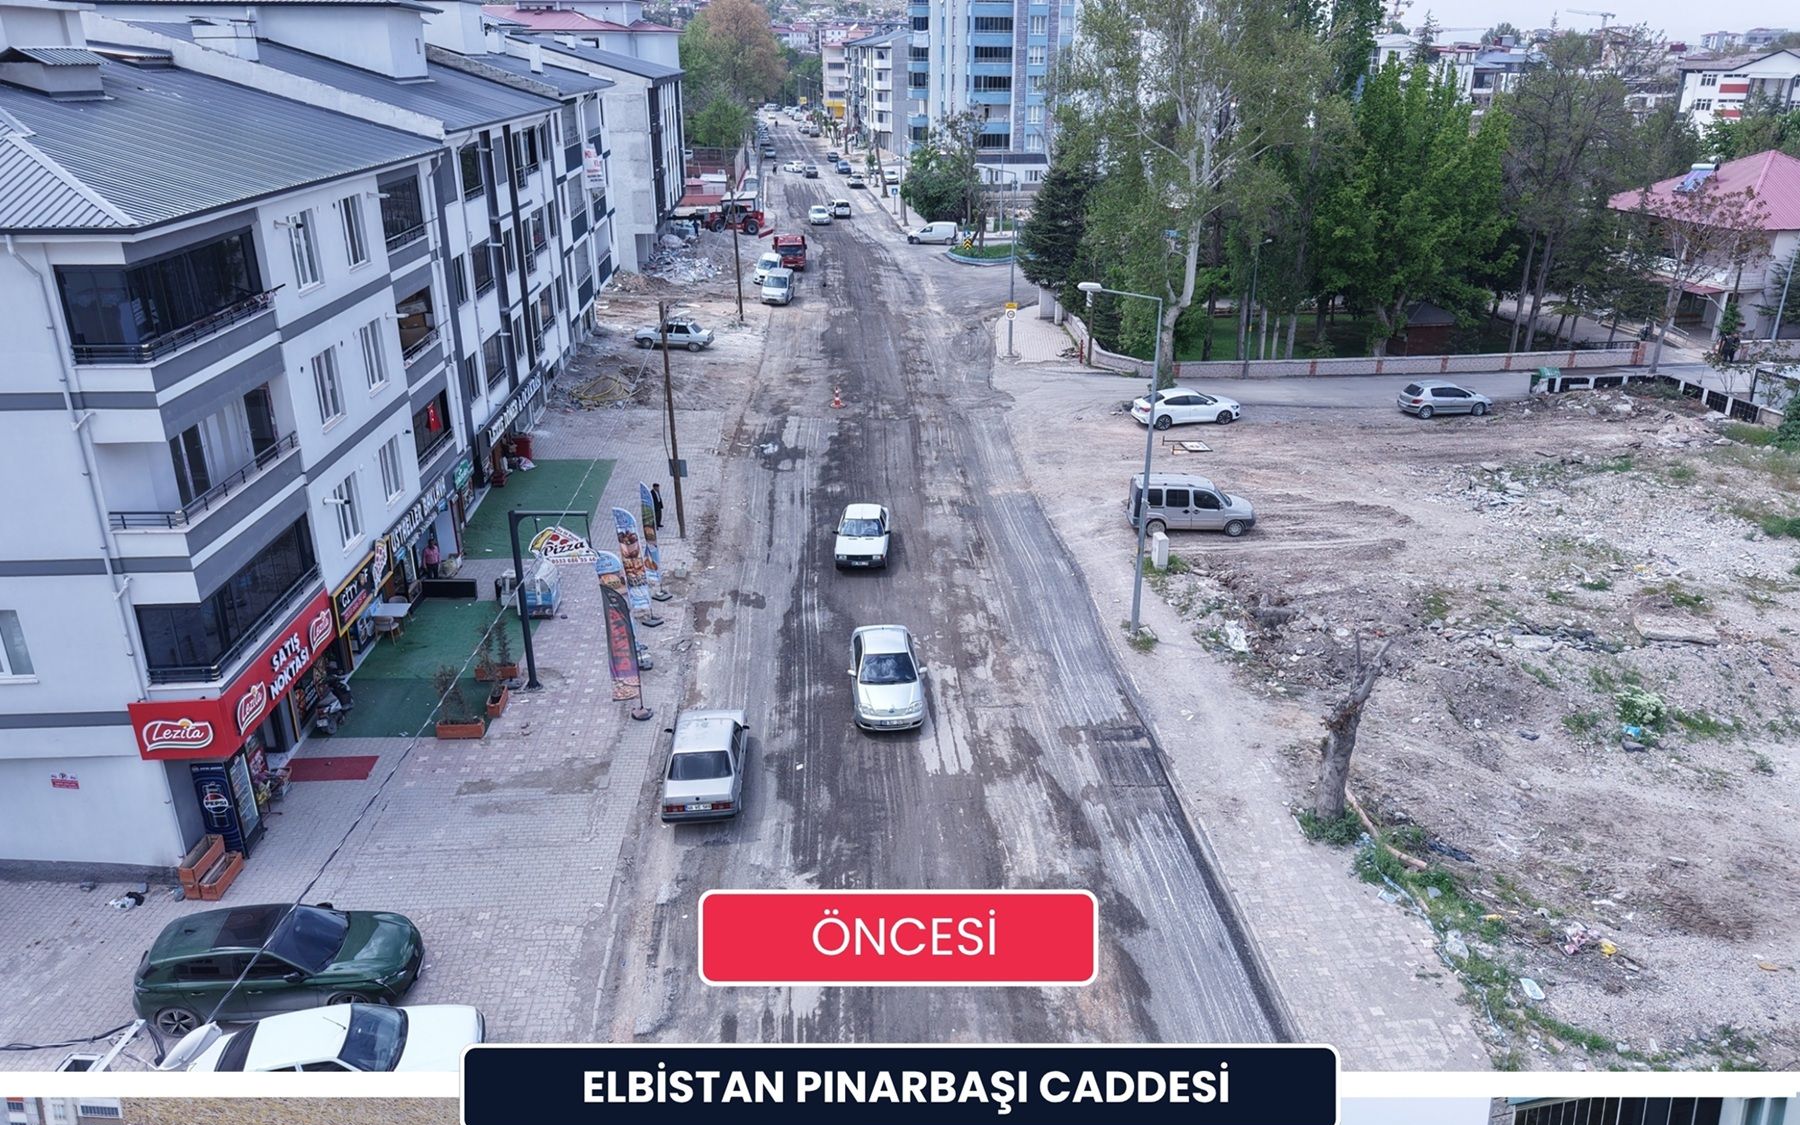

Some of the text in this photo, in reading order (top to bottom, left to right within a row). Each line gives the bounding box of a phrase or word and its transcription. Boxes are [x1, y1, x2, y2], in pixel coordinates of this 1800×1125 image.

[543, 541, 585, 557] Pizza
[272, 632, 300, 672] SATIŞ
[269, 646, 310, 700] NOKTASI
[152, 721, 205, 741] Lezita
